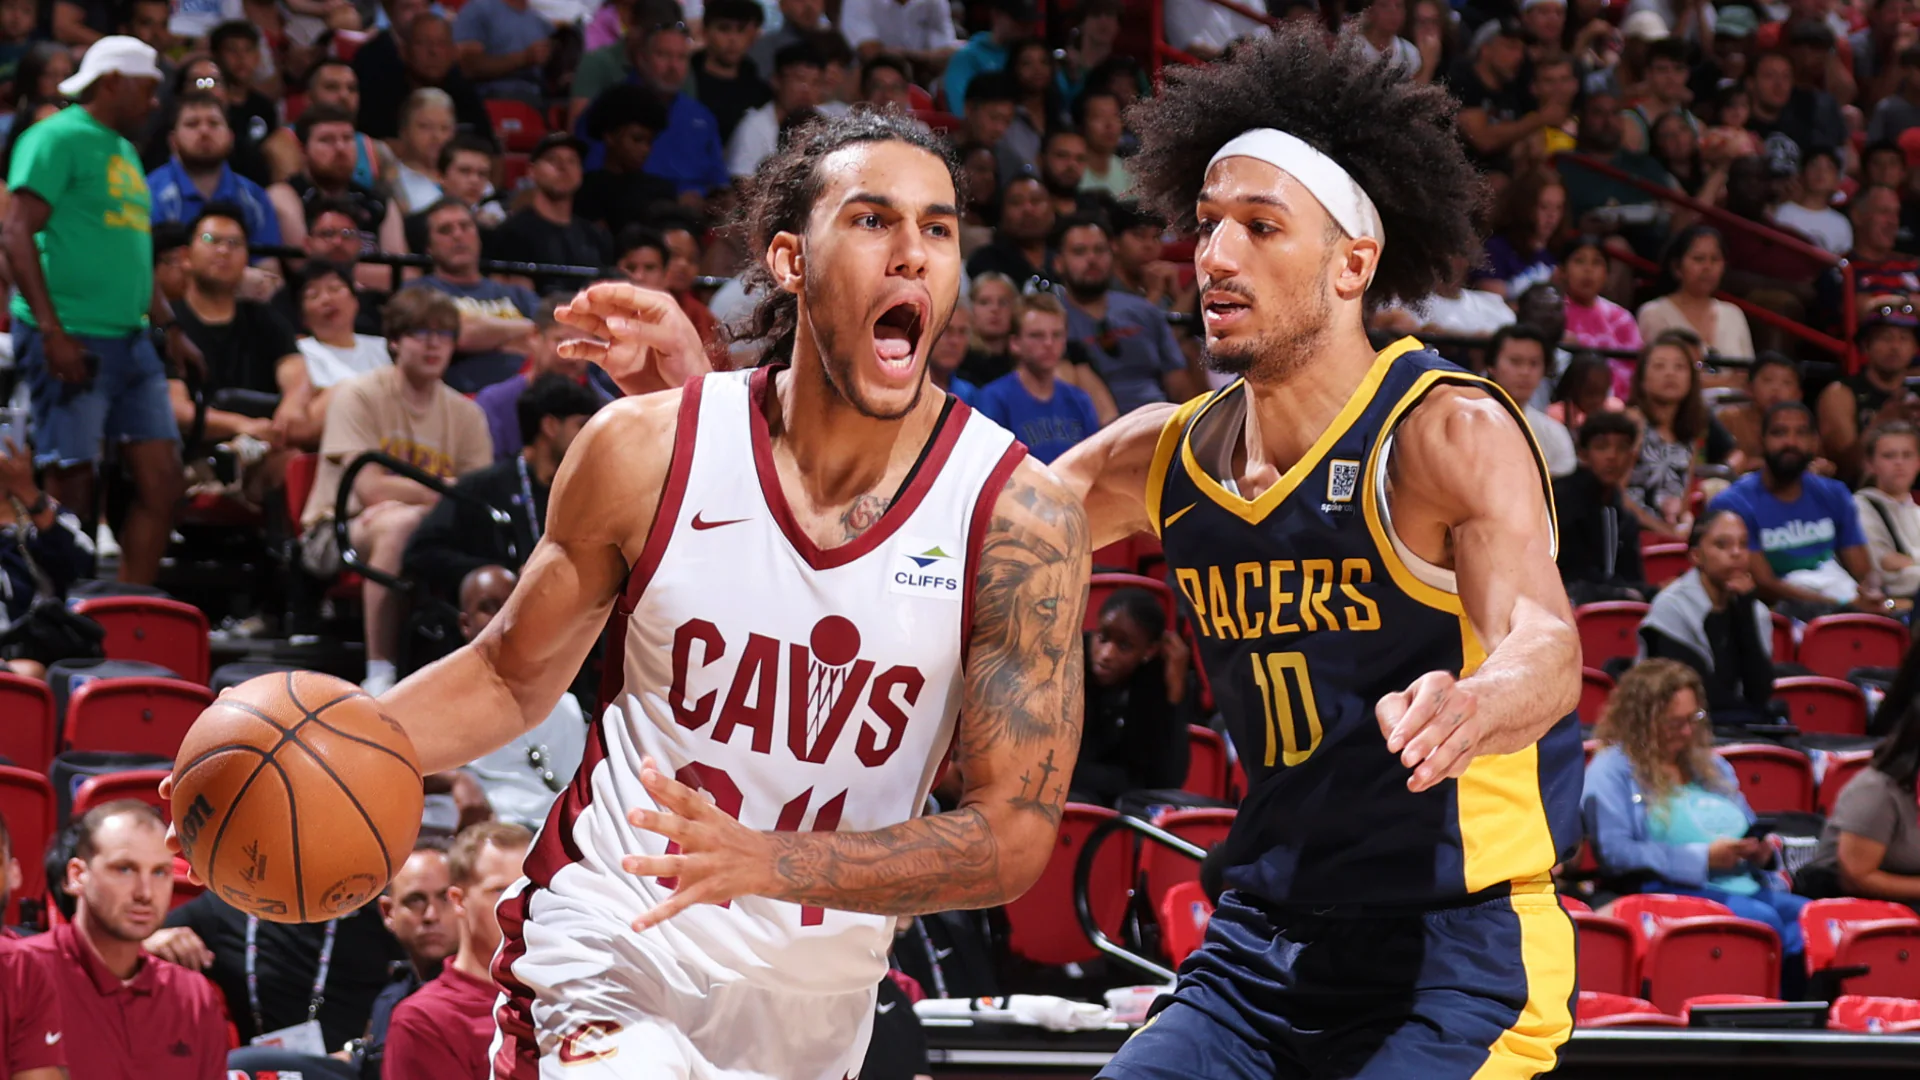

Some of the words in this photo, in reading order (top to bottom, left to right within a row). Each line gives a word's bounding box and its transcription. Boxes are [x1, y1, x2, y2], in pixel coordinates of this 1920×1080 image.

[895, 572, 957, 590] CLIFFS
[1175, 558, 1382, 640] PACERS
[668, 615, 925, 768] CAVS
[1251, 651, 1323, 767] 10
